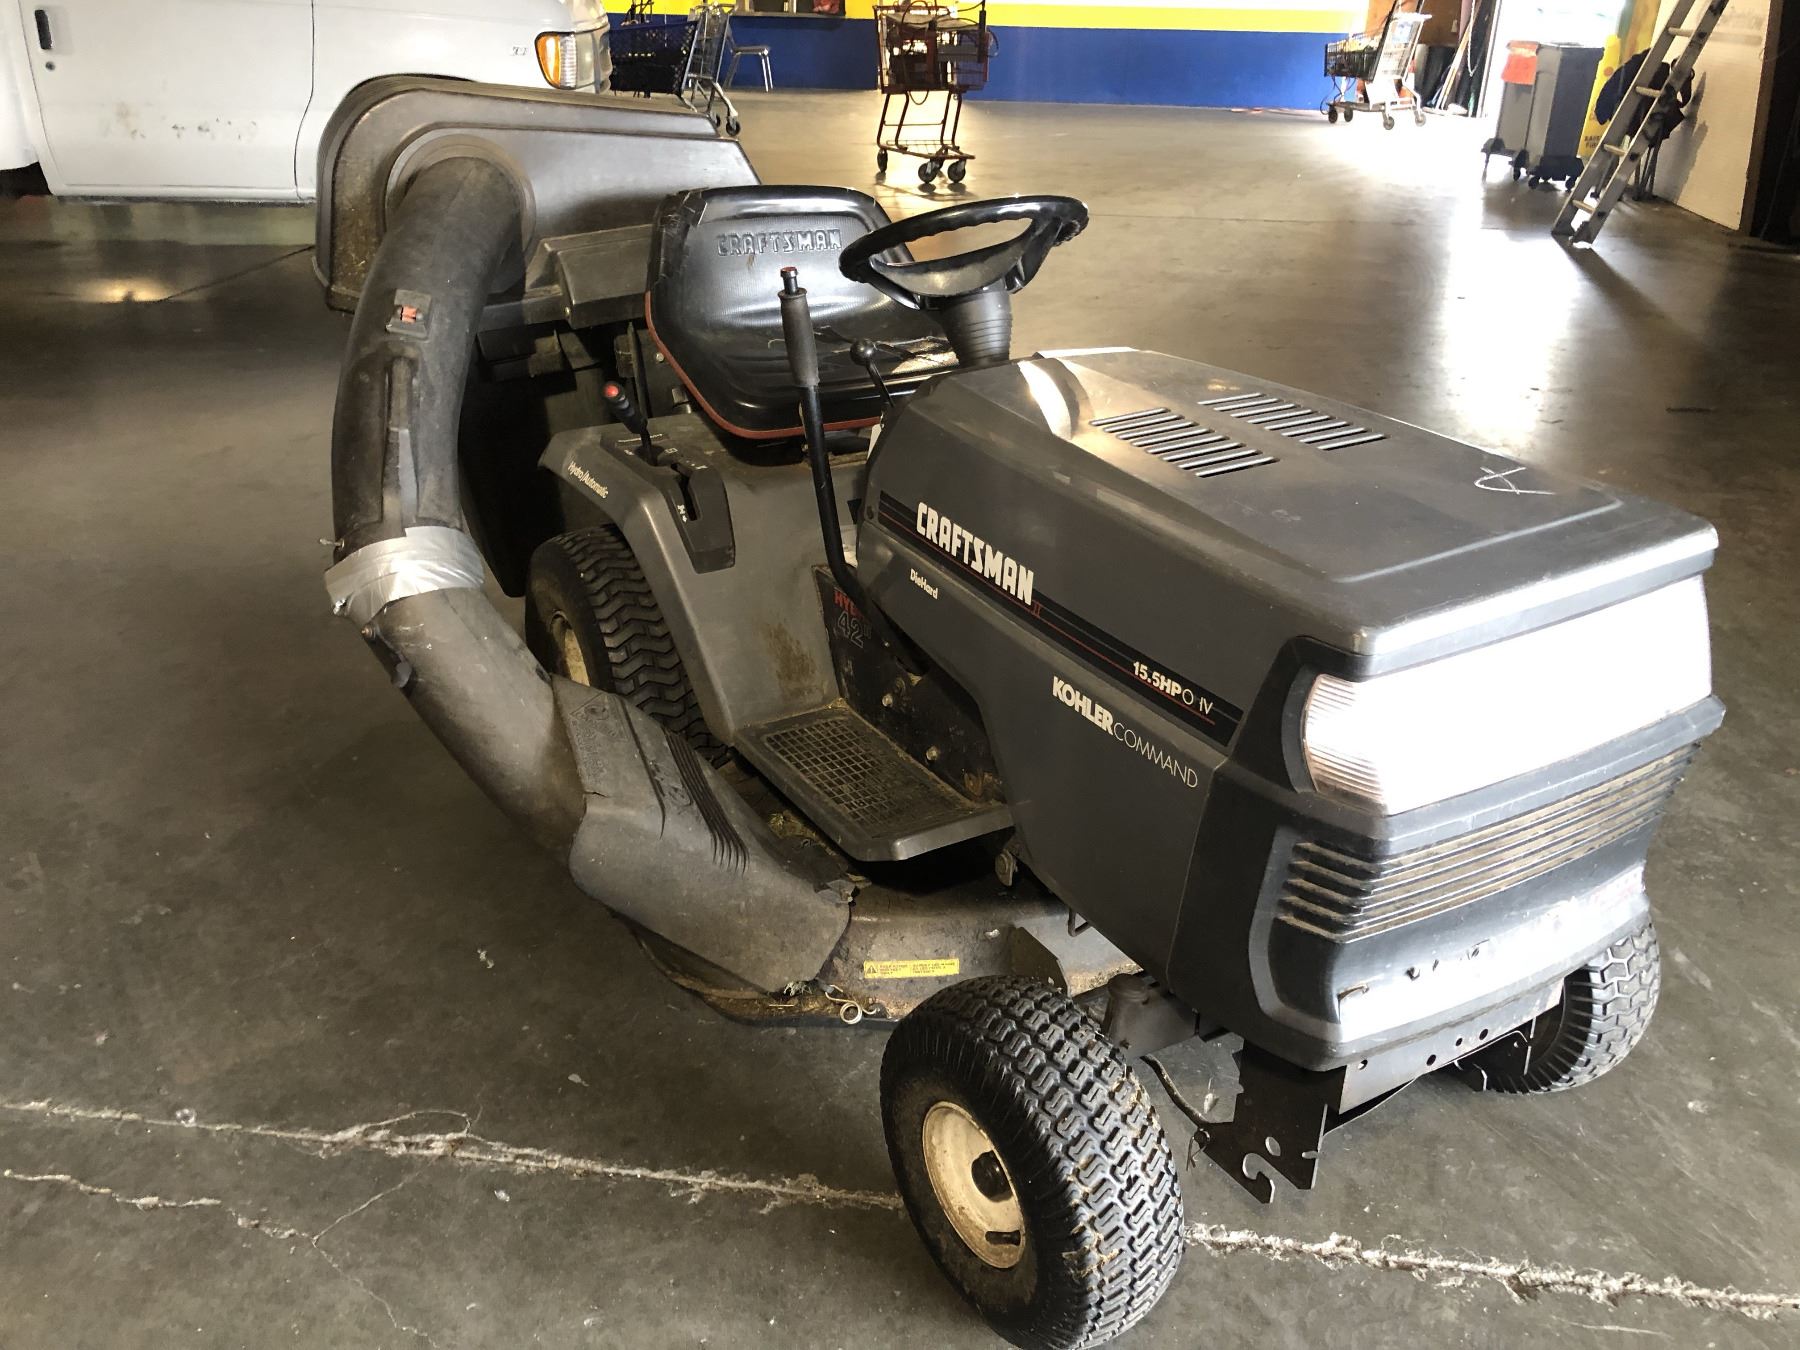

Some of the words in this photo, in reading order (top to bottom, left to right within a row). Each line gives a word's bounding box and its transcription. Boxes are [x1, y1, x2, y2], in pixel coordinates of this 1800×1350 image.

[716, 229, 842, 256] CRAFTSMAN
[916, 501, 1034, 605] CRAFTSMAN
[910, 568, 939, 600] DieHard
